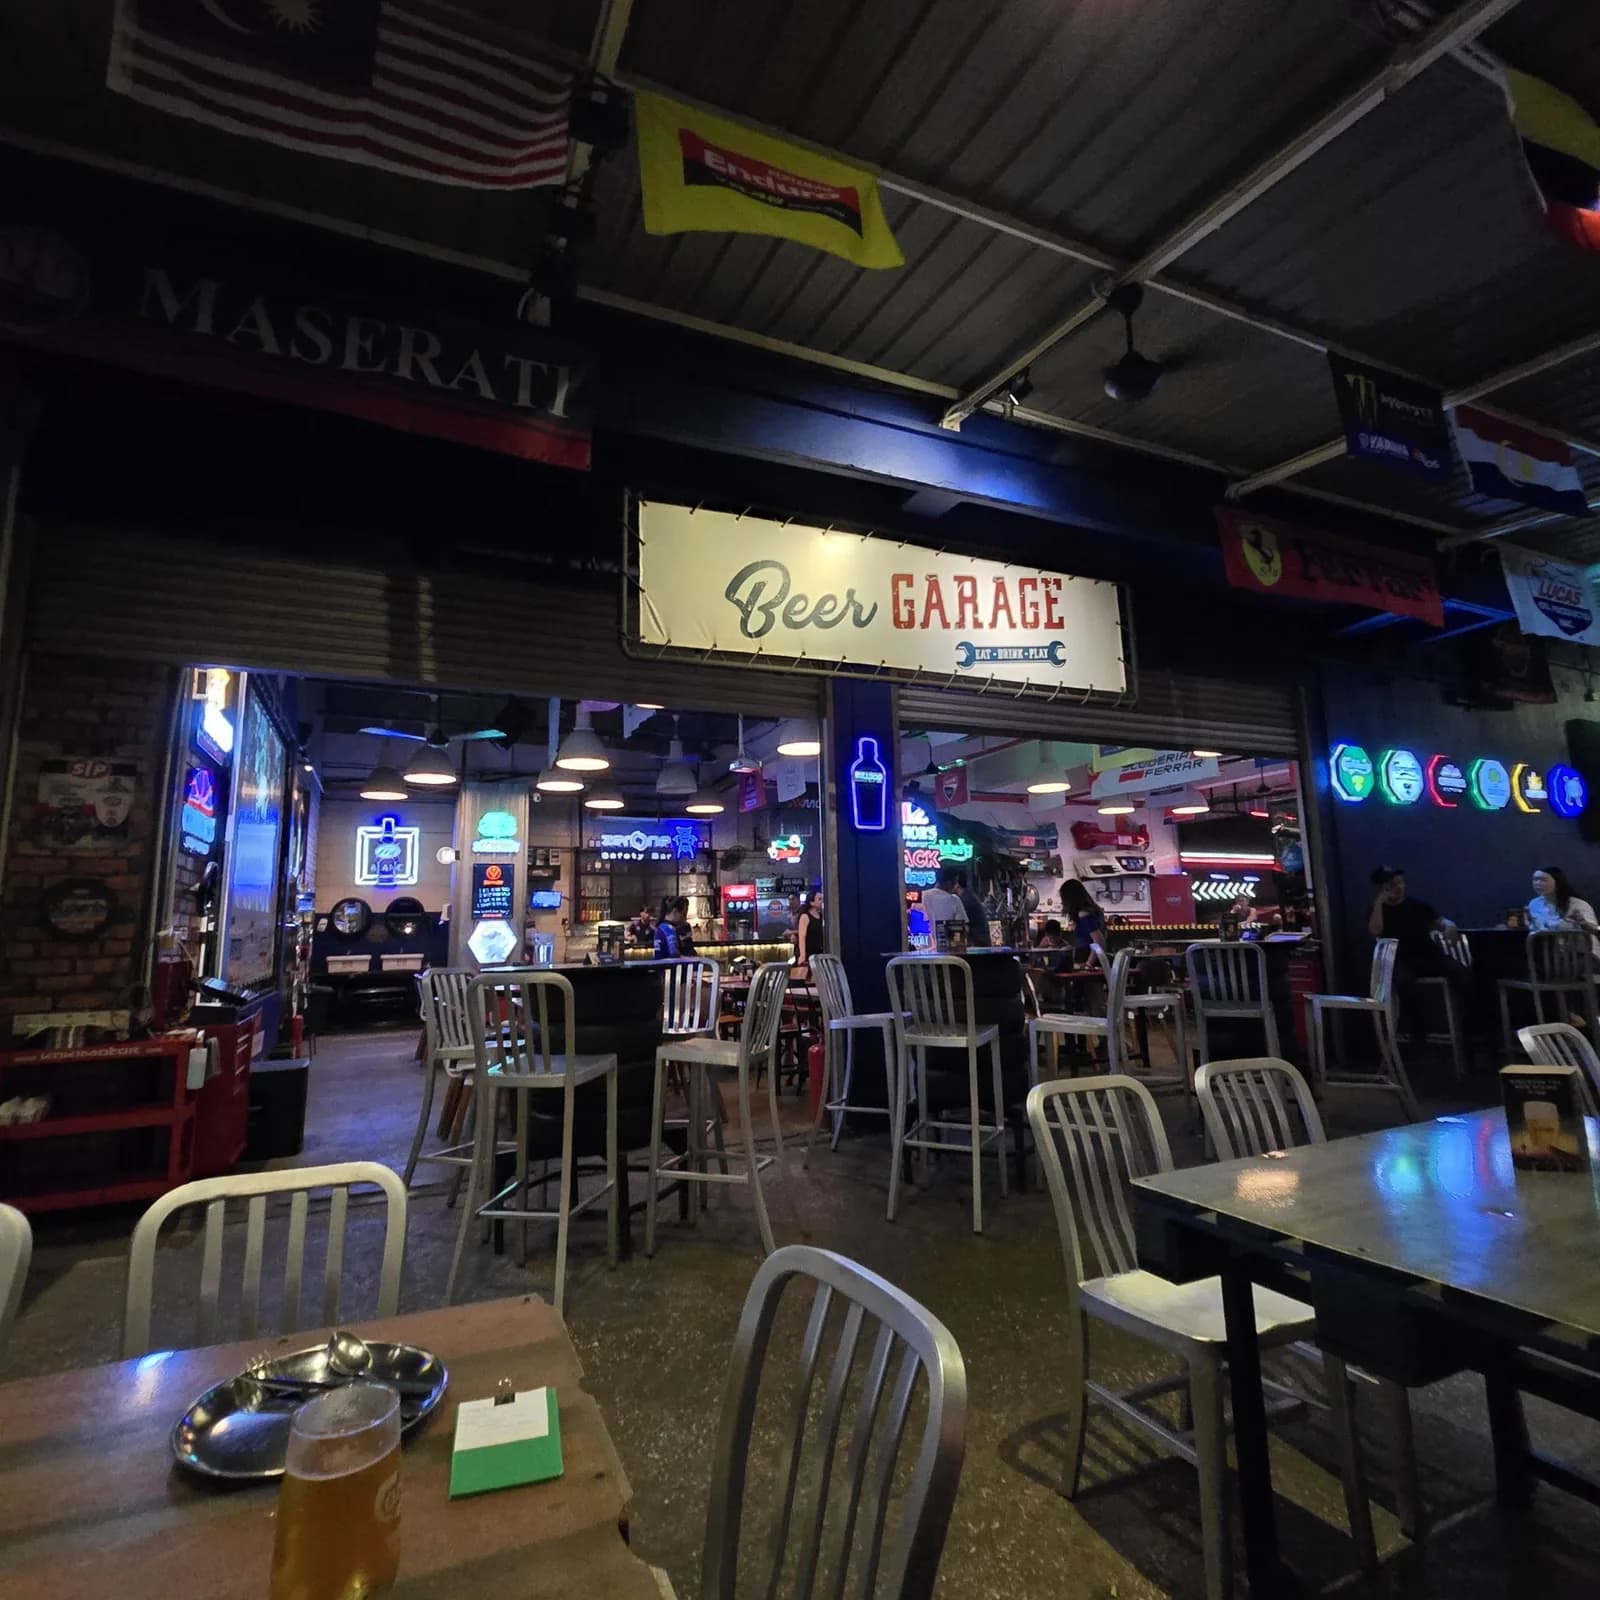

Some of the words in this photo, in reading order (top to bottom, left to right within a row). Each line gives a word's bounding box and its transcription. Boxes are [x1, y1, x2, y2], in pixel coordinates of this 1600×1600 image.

[138, 266, 572, 419] MASERATI
[725, 560, 878, 639] Beer
[891, 573, 1065, 630] GARAGE
[1539, 580, 1582, 606] LUCAS
[975, 648, 991, 660] EAT
[998, 648, 1024, 660] DRINK
[1029, 648, 1048, 660] PLAY
[1144, 758, 1205, 778] FERRAR
[651, 851, 672, 860] Bar
